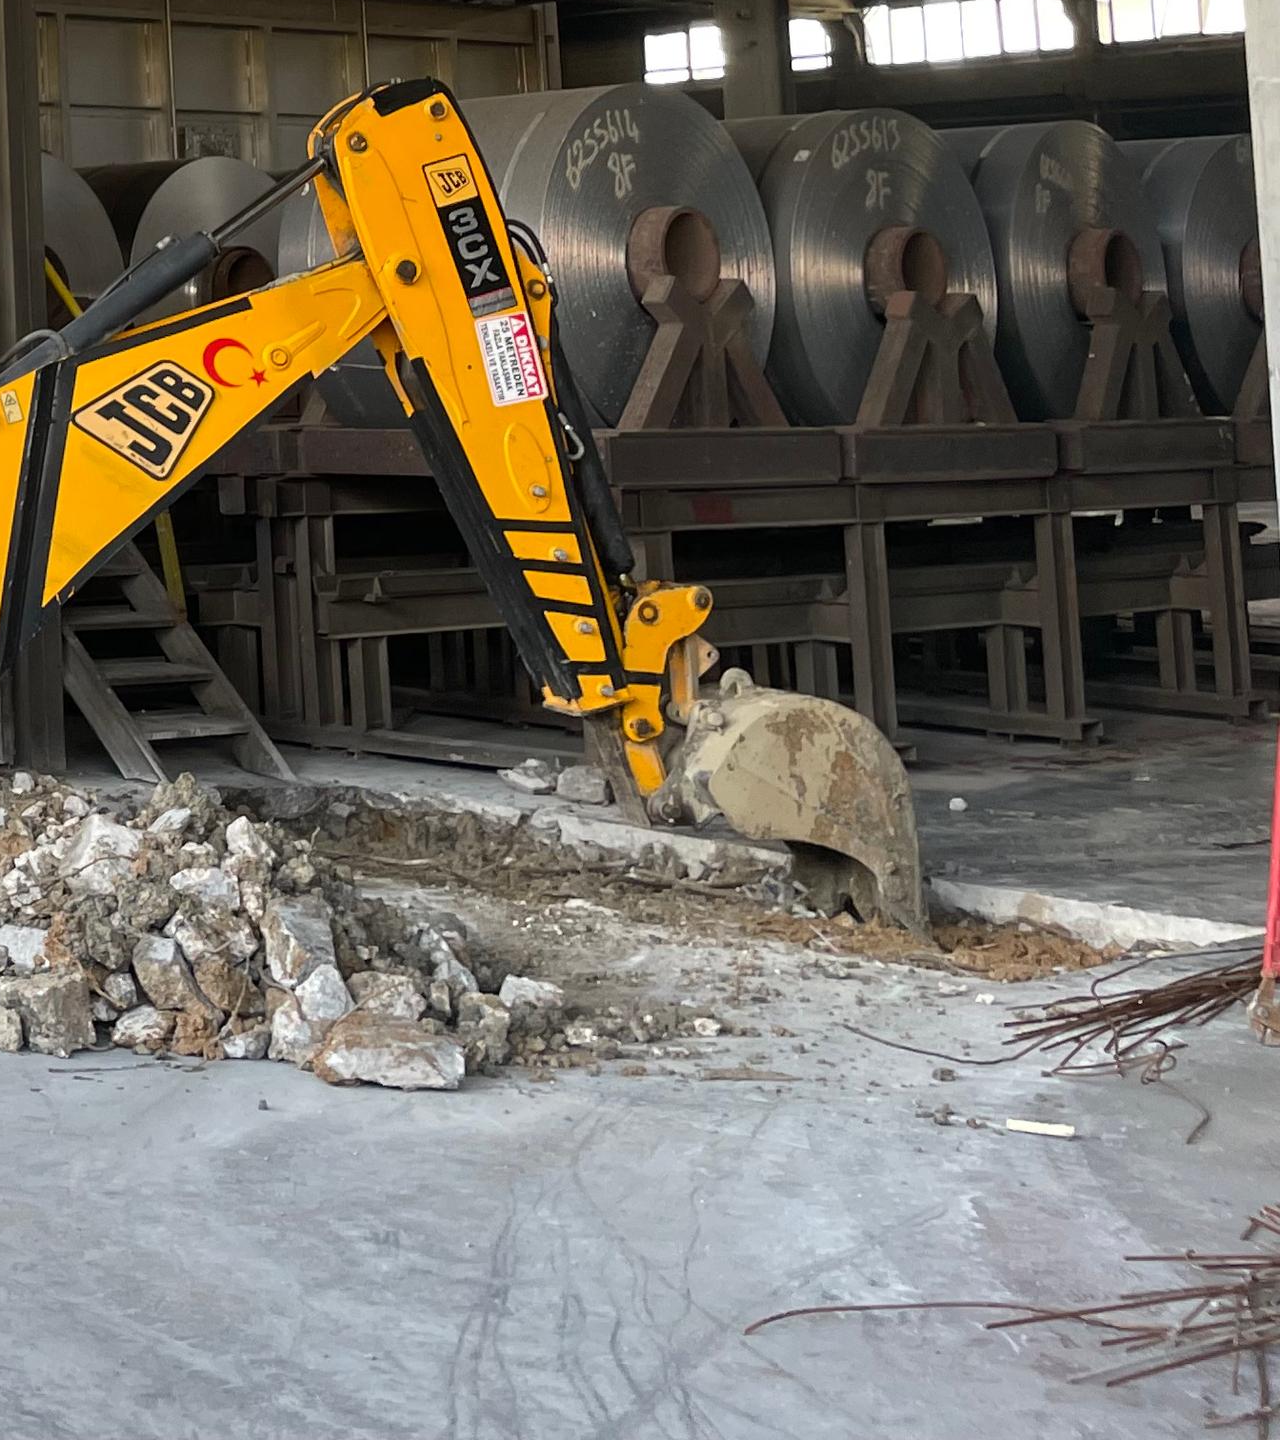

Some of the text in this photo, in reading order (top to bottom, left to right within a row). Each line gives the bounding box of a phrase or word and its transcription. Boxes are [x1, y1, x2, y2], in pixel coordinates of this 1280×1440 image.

[437, 170, 467, 194] JCB
[607, 152, 636, 199] 8F
[448, 206, 500, 289] 3CX
[500, 319, 525, 396] 25 METREDEN
[95, 369, 205, 466] JCB
